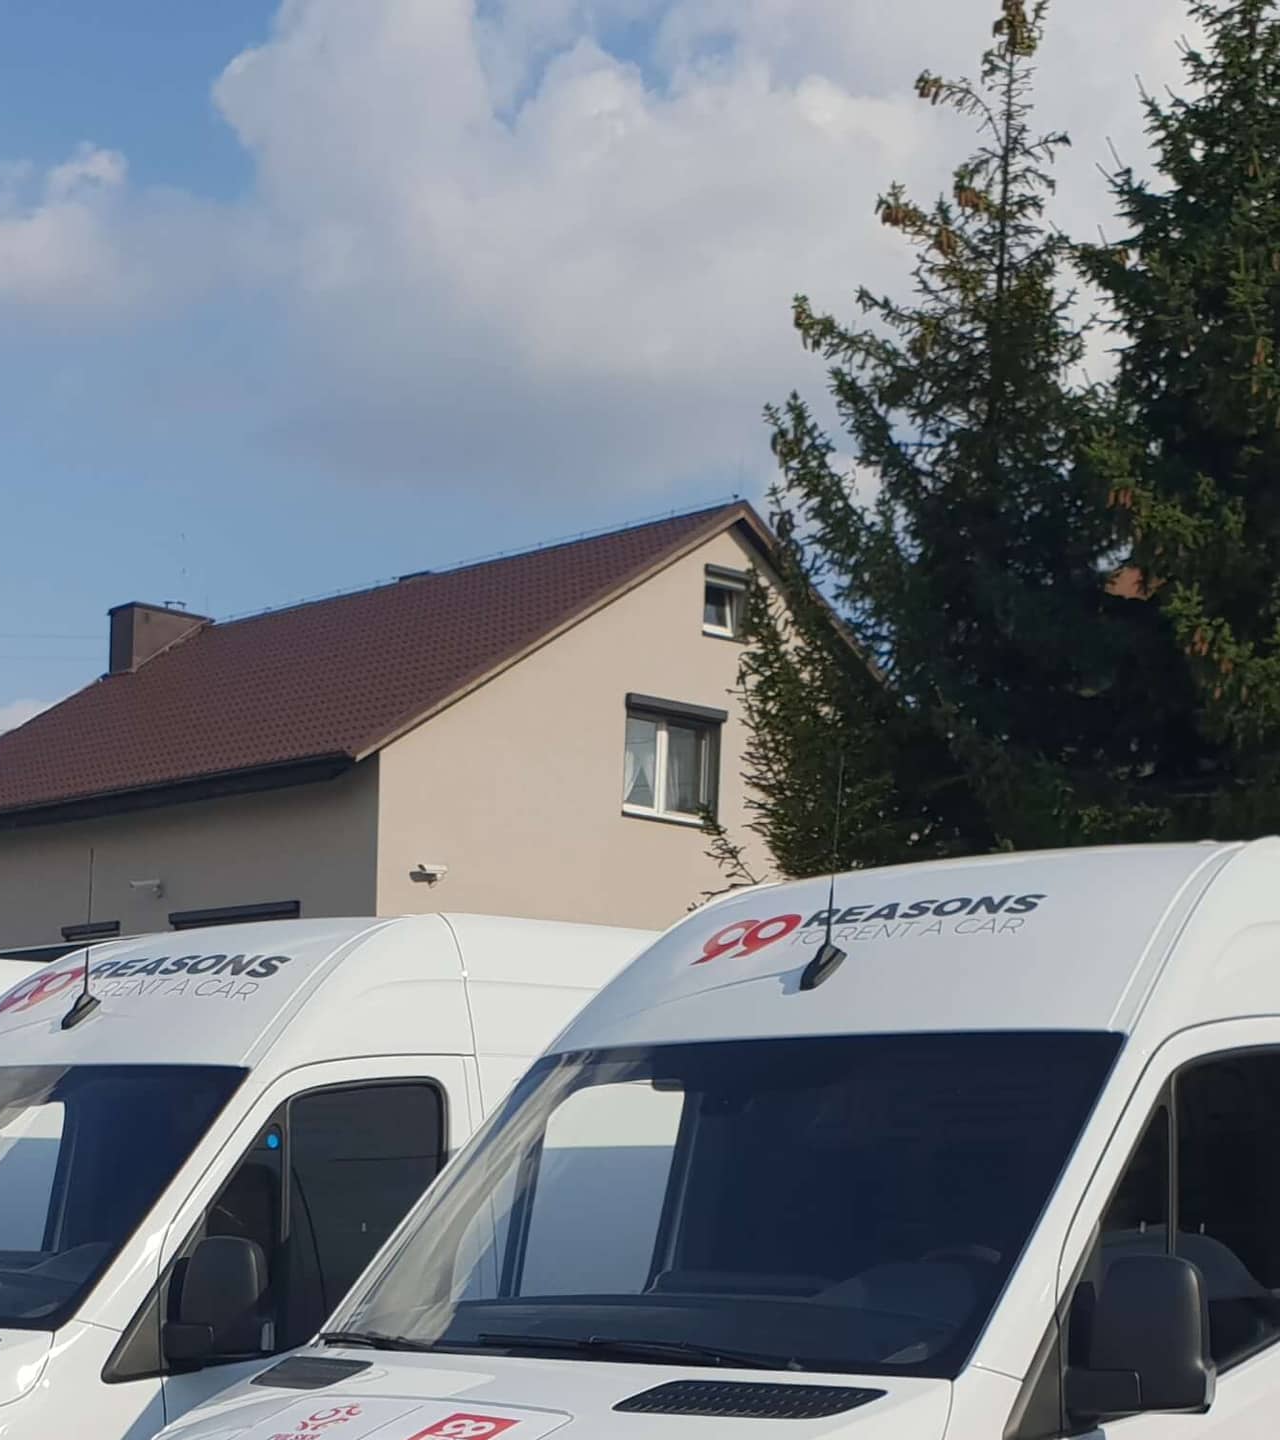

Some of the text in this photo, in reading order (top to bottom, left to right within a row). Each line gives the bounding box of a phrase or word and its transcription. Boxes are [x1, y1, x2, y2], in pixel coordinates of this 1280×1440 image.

[690, 893, 1048, 966] 99 REASONS
[833, 921, 915, 943] RENT
[920, 921, 942, 936] A
[954, 917, 1025, 936] CAR
[89, 954, 292, 980] REASONS
